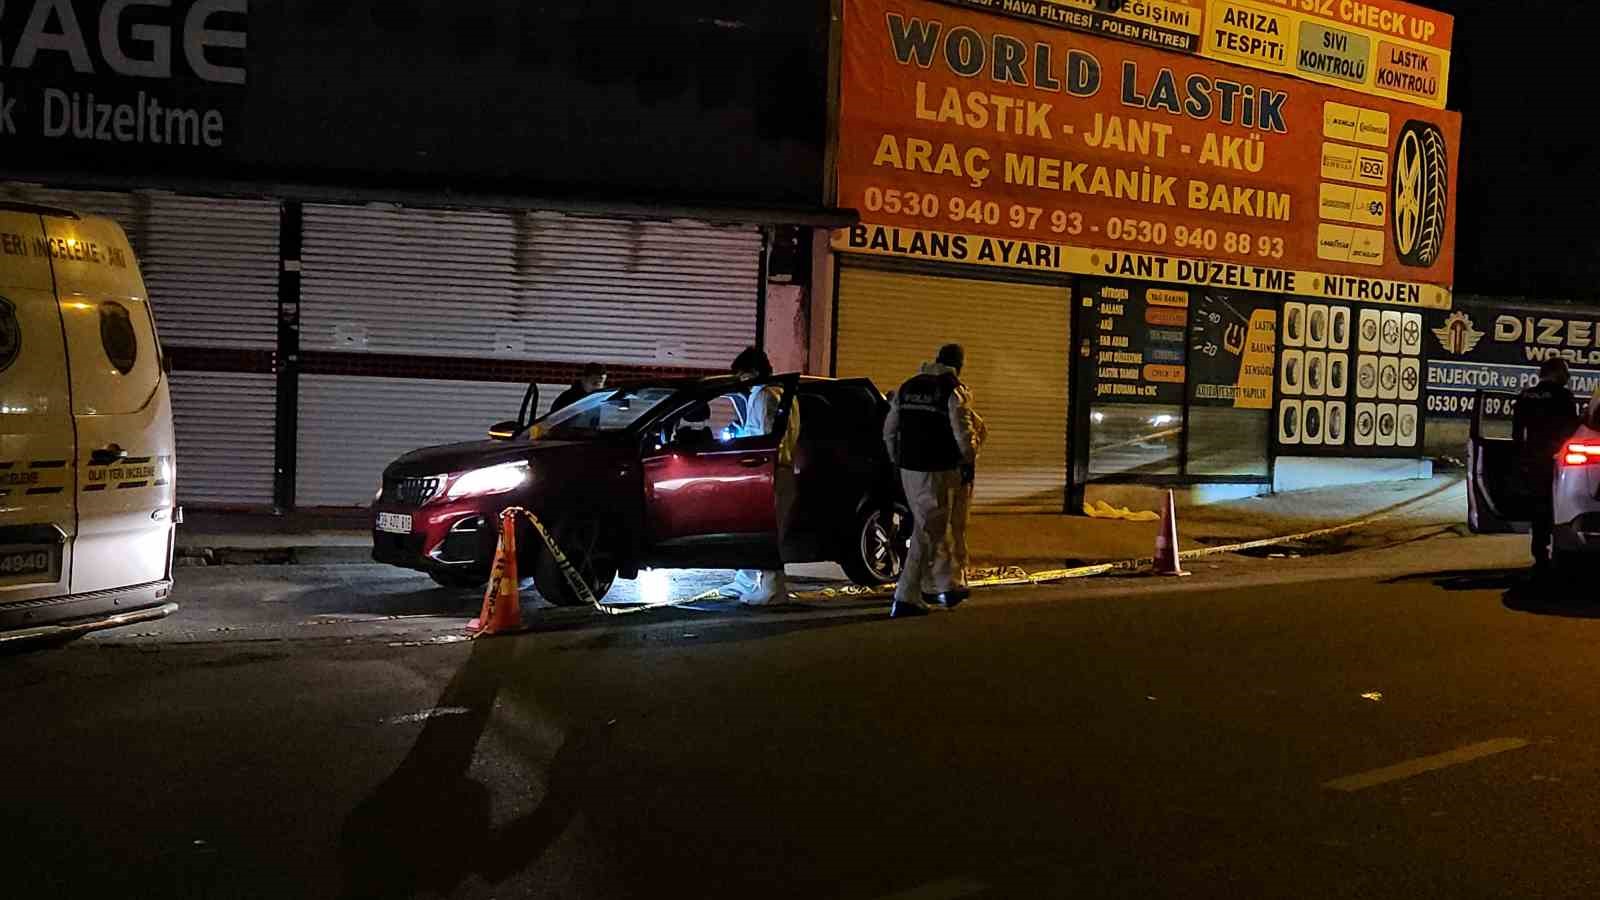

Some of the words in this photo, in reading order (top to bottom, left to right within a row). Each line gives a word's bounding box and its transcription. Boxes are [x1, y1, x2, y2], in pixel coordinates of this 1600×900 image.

[1003, 0, 1037, 17] HAVA
[1102, 19, 1139, 39] POLEN
[1119, 0, 1190, 27] EĞİŞİMİ
[1224, 7, 1279, 36] ARIZA
[1340, 1, 1405, 34] CHECK
[1411, 18, 1435, 42] UP
[0, 0, 248, 84] AGE
[886, 12, 1101, 97] WORLD
[1323, 31, 1347, 52] SIVI
[1299, 49, 1365, 80] KONTROLÜ
[1378, 67, 1436, 96] KONTROLÜ
[43, 87, 223, 147] Düzeltme
[1084, 113, 1172, 158] JANT
[1199, 132, 1265, 173] AKÜ
[872, 134, 990, 188] ARAÇ
[1004, 152, 1177, 206] MEKANİK
[1188, 180, 1291, 221] BAKIM
[864, 187, 939, 218] 0530
[950, 197, 1000, 225] 940
[1009, 205, 1042, 230] 97
[1050, 210, 1083, 235] 93
[1106, 216, 1167, 245] 0530
[1174, 226, 1216, 251] 940
[1224, 231, 1251, 255] 88
[1258, 235, 1285, 258] 93
[849, 223, 968, 259] BALANS
[977, 238, 1061, 269] AYARI
[1104, 253, 1169, 279] JANT
[1203, 342, 1217, 356] 20
[1494, 314, 1600, 348] DIZE
[1427, 367, 1498, 387] ENJEKTÖR
[1502, 375, 1517, 387] ve
[1427, 395, 1458, 412] 0530
[1460, 396, 1474, 411] 94
[1485, 398, 1500, 414] 89
